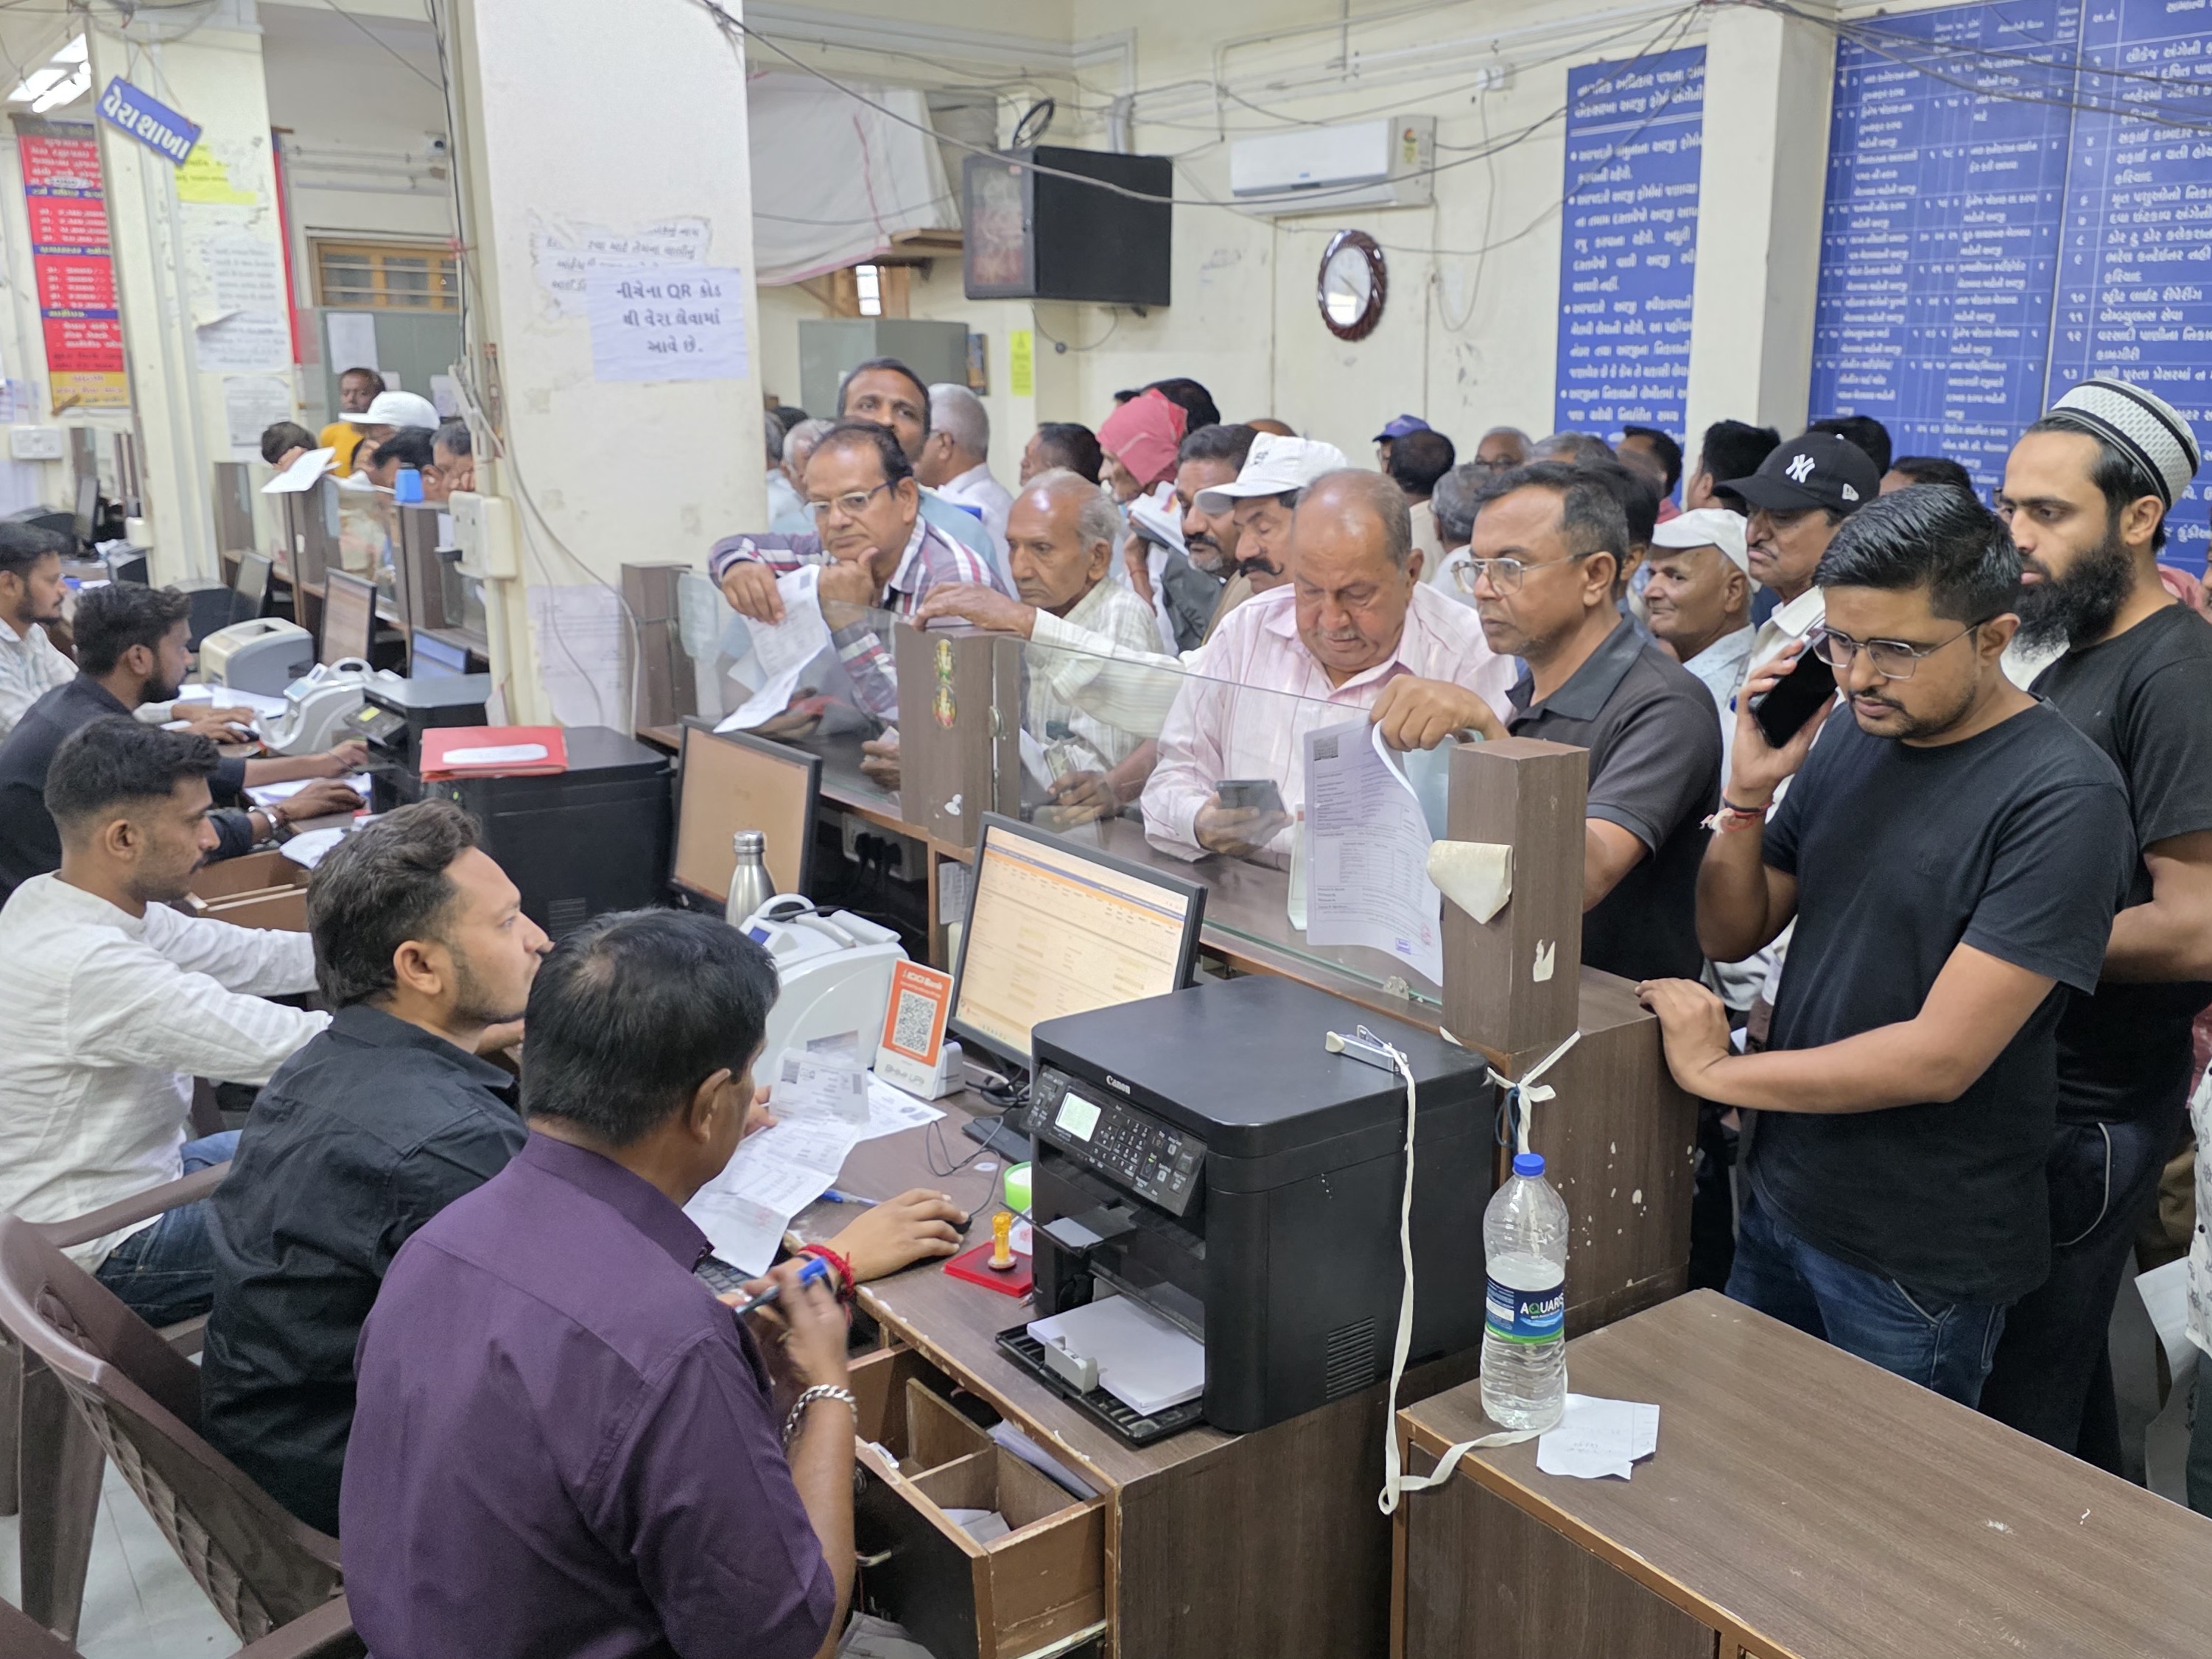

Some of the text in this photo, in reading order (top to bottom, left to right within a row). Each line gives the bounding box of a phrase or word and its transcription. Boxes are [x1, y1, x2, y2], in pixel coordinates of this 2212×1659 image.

[667, 284, 692, 301] QR
[647, 336, 678, 354] આવે
[1106, 1075, 1131, 1095] Canon
